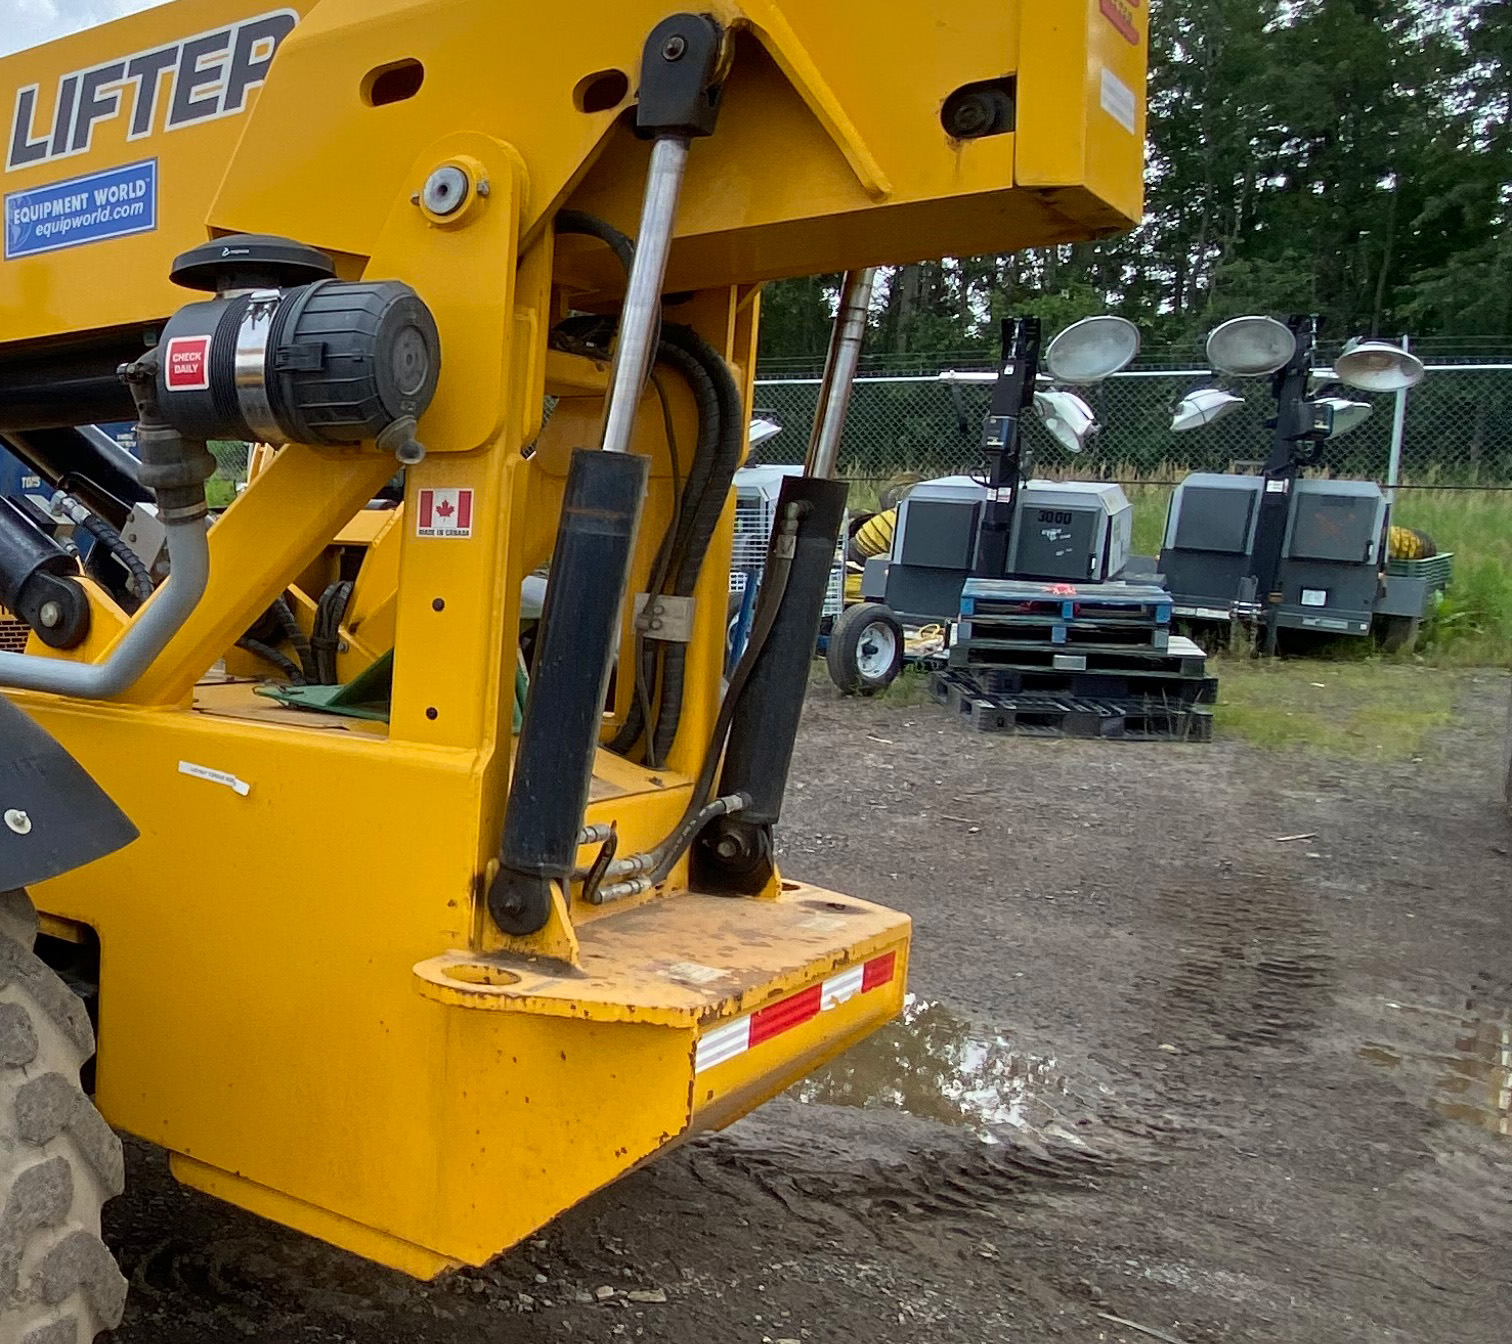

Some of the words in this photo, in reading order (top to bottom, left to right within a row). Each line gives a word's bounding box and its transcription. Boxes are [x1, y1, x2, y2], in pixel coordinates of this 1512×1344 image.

[5, 8, 299, 172] LIFTER
[14, 193, 89, 225] EQUIPMENT
[93, 179, 146, 206] WORLD
[35, 201, 144, 238] equipworld.com
[172, 352, 202, 363] CHECK
[174, 364, 199, 374] DAILY
[1037, 509, 1073, 525] 3000
